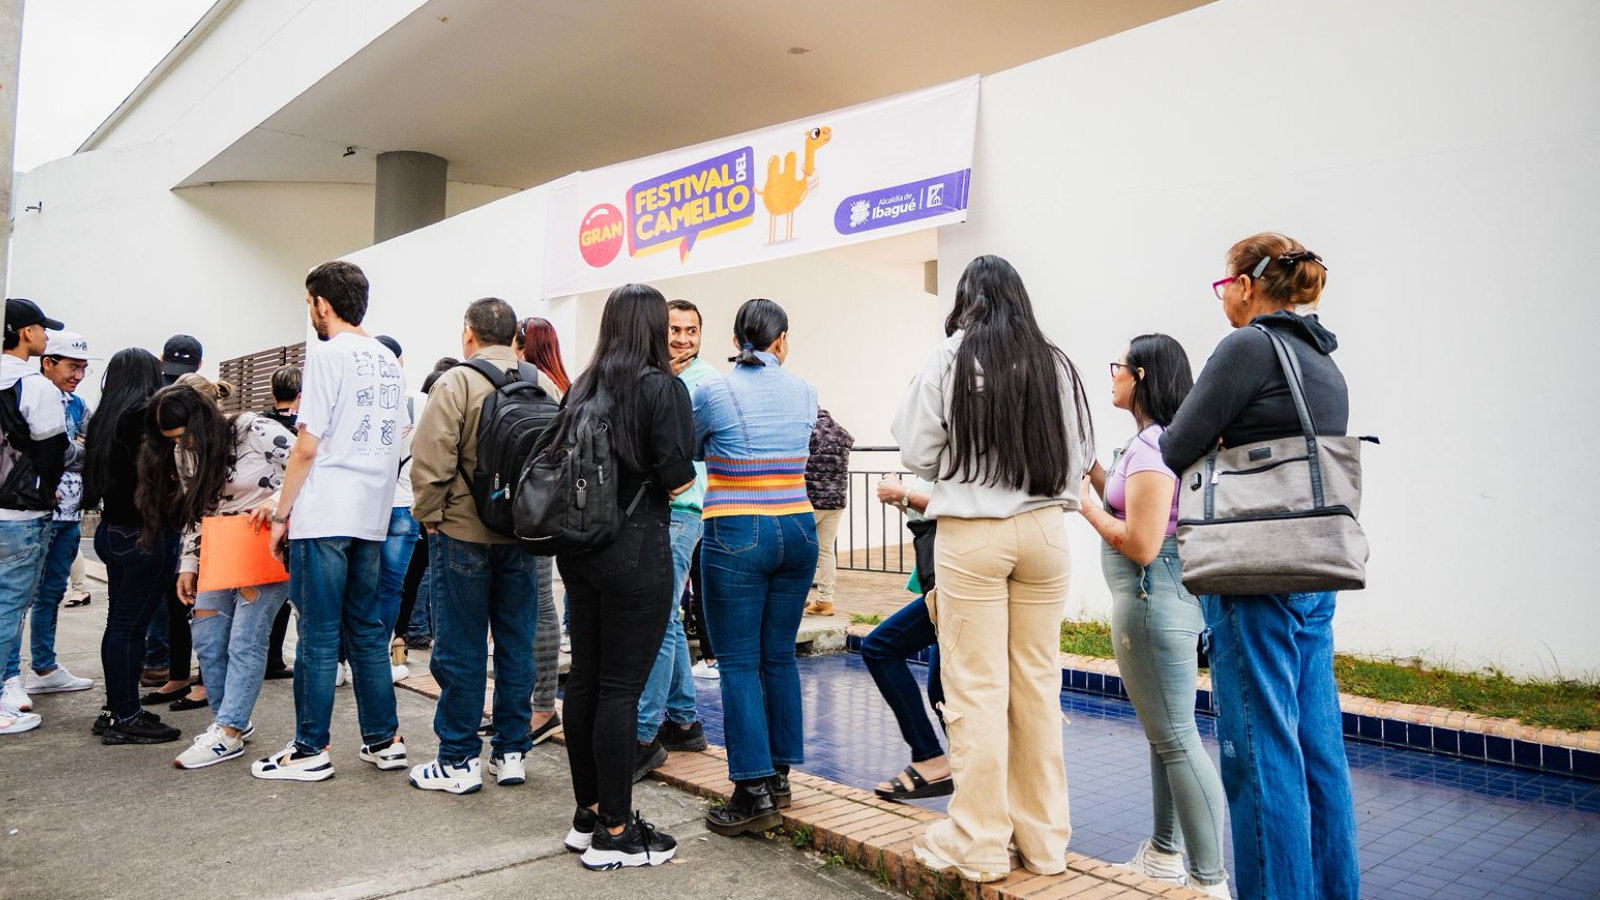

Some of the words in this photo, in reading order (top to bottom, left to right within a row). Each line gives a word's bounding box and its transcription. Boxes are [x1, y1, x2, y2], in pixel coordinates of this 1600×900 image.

[635, 164, 735, 215] FESTIVAL
[735, 152, 747, 183] DEL
[903, 192, 913, 201] de
[636, 184, 750, 241] CAMELLO
[872, 198, 917, 220] Ibagué
[580, 220, 624, 247] GRAN
